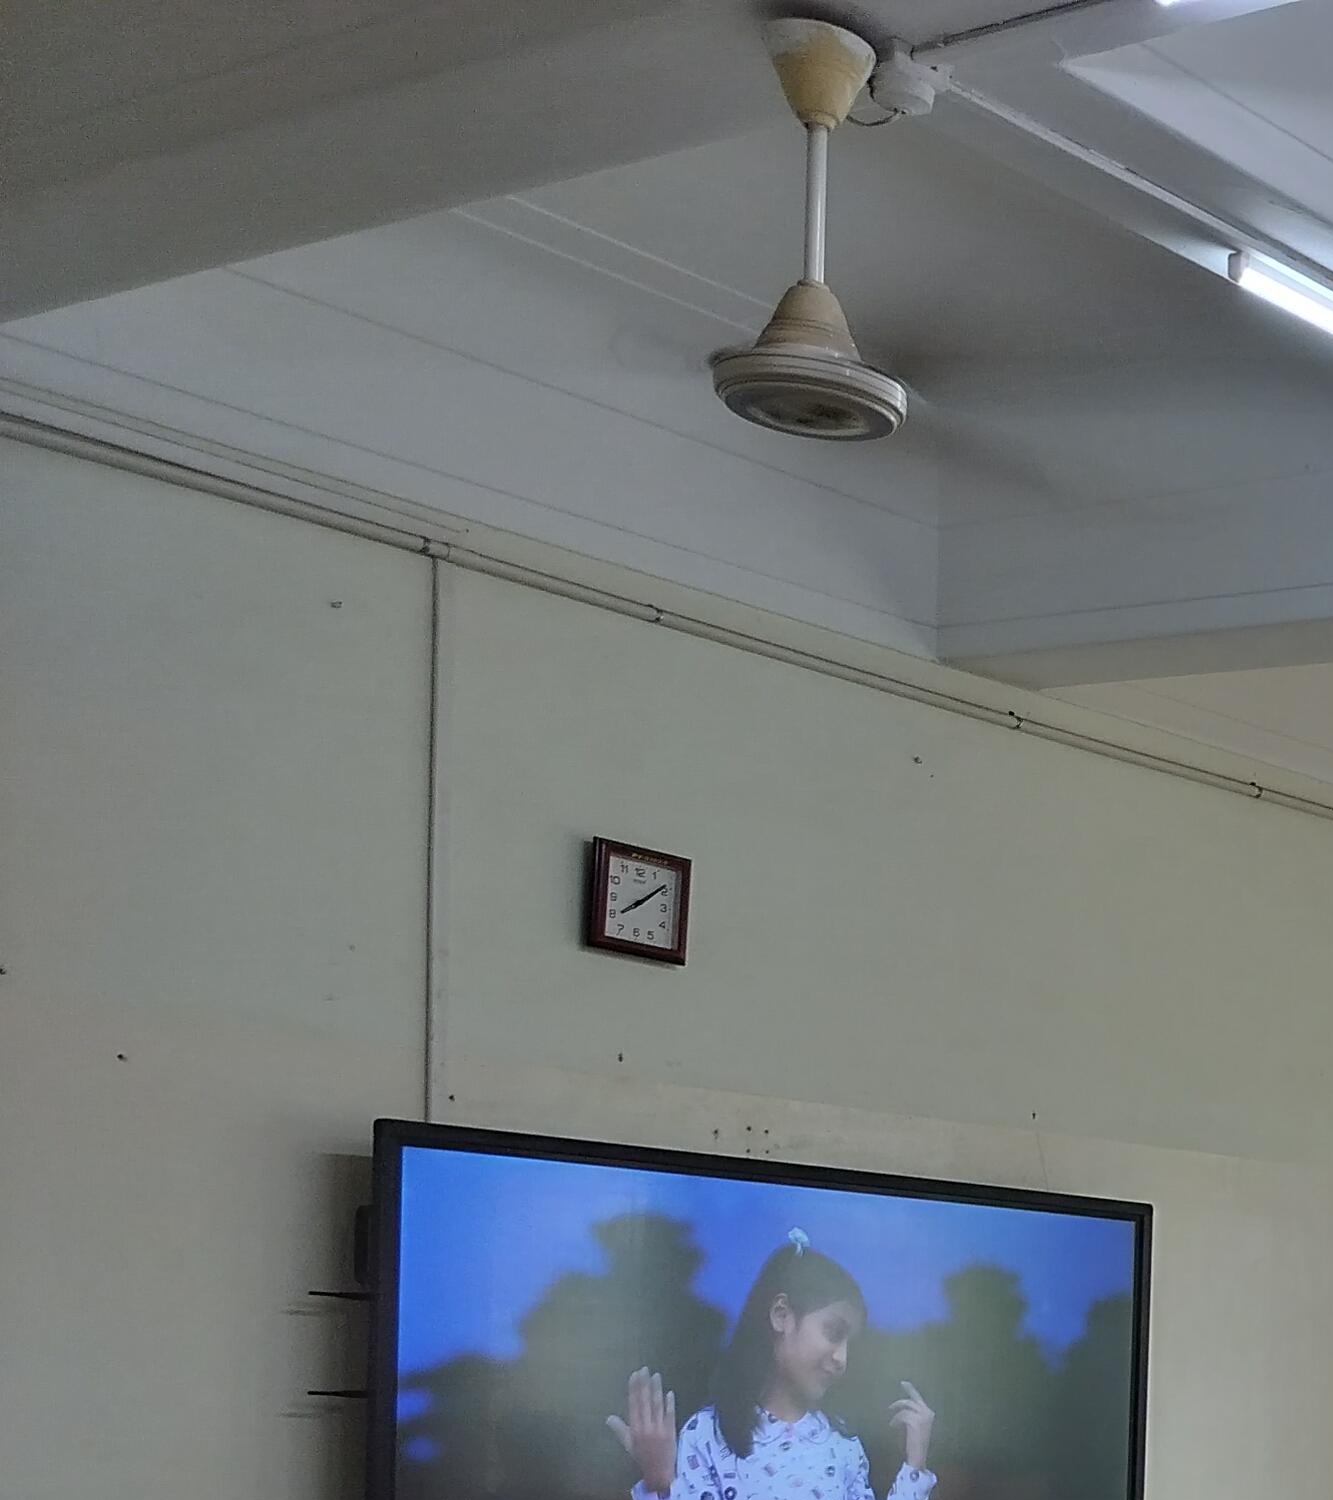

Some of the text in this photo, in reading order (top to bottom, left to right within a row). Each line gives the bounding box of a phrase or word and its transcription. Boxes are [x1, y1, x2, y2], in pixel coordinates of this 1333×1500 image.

[635, 868, 646, 878] 12
[610, 874, 621, 885] 10
[610, 892, 617, 902] 9
[660, 904, 668, 913] 3
[609, 909, 617, 919] 8
[617, 924, 625, 935] 7
[659, 921, 666, 929] 4
[632, 928, 641, 938] 6
[646, 931, 655, 940] 5
